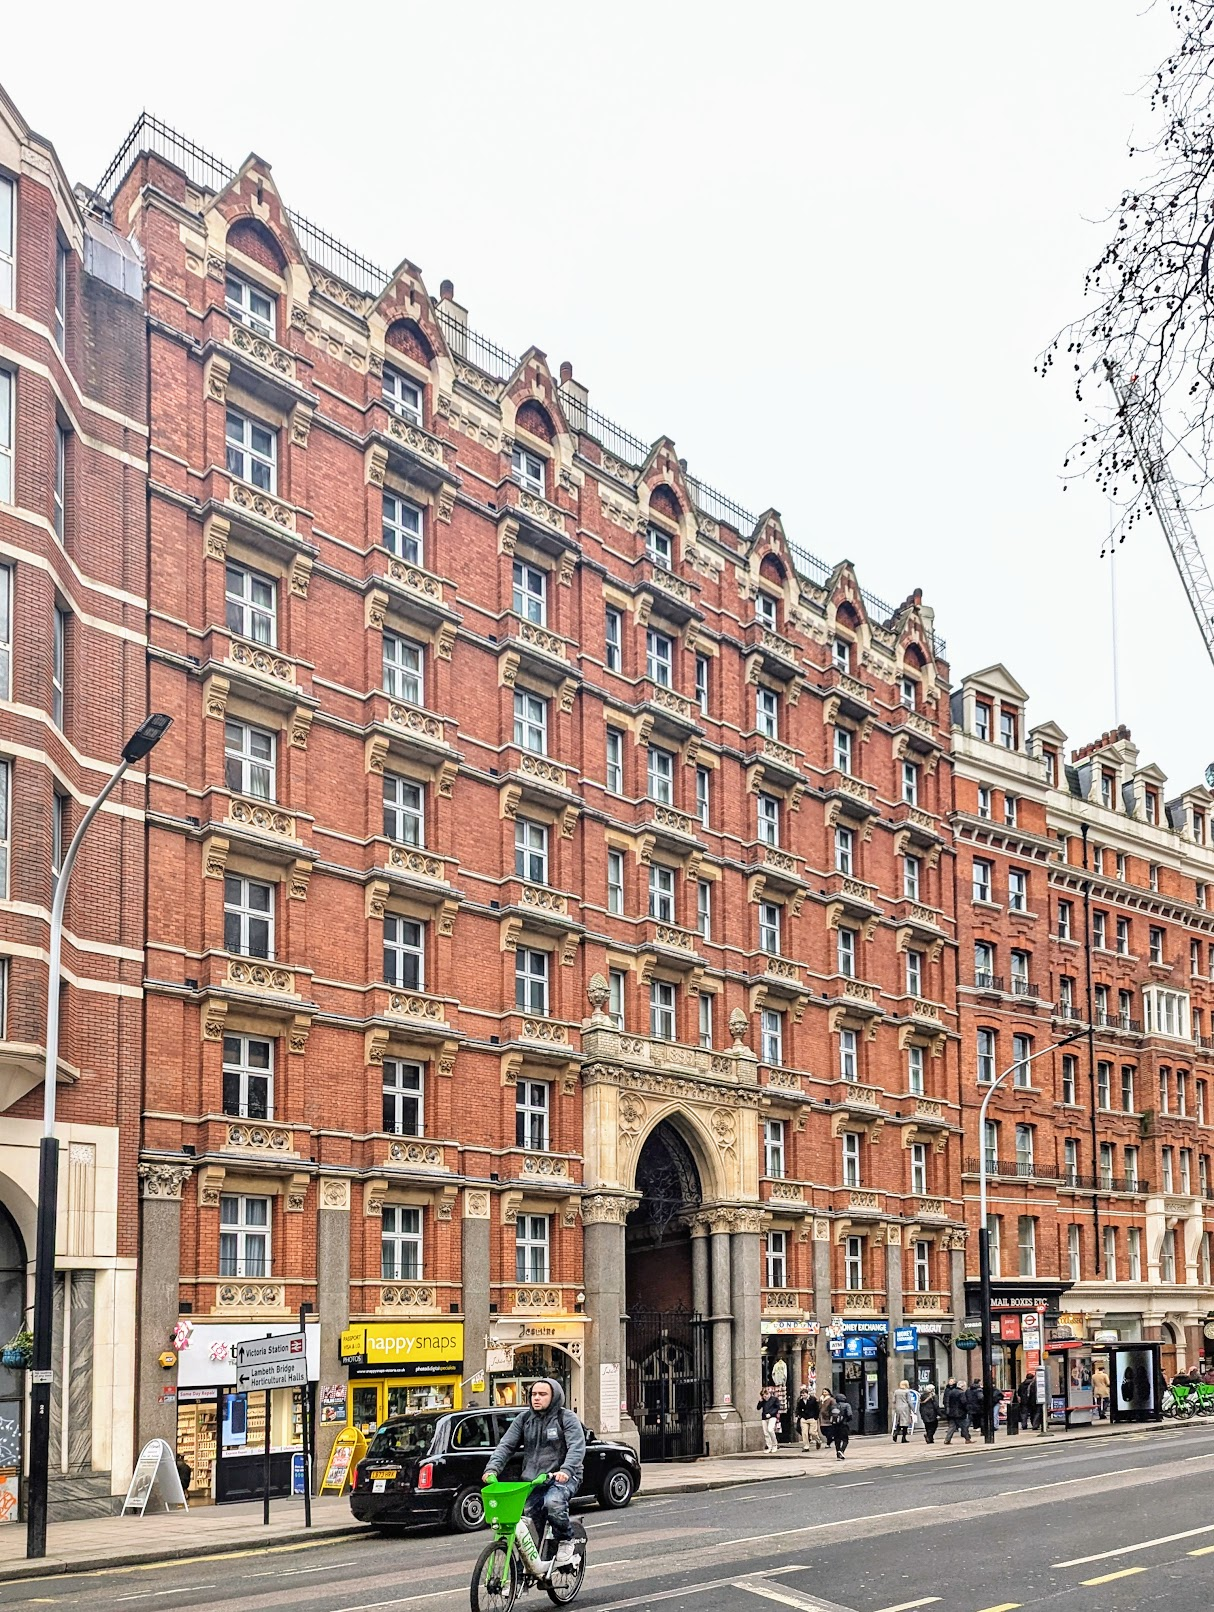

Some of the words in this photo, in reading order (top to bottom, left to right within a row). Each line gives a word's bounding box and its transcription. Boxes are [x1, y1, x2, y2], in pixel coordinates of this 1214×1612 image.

[990, 1298, 1009, 1306] MAIL
[1010, 1298, 1032, 1306] BOXES
[910, 1324, 942, 1333] NI&GUY
[246, 1347, 266, 1357] Victoria
[268, 1345, 289, 1354] Station
[251, 1367, 274, 1376] Lambeth
[277, 1365, 294, 1374] Bridge
[251, 1375, 287, 1386] Horticultural
[288, 1374, 304, 1382] Halls
[522, 1533, 538, 1562] Lime
